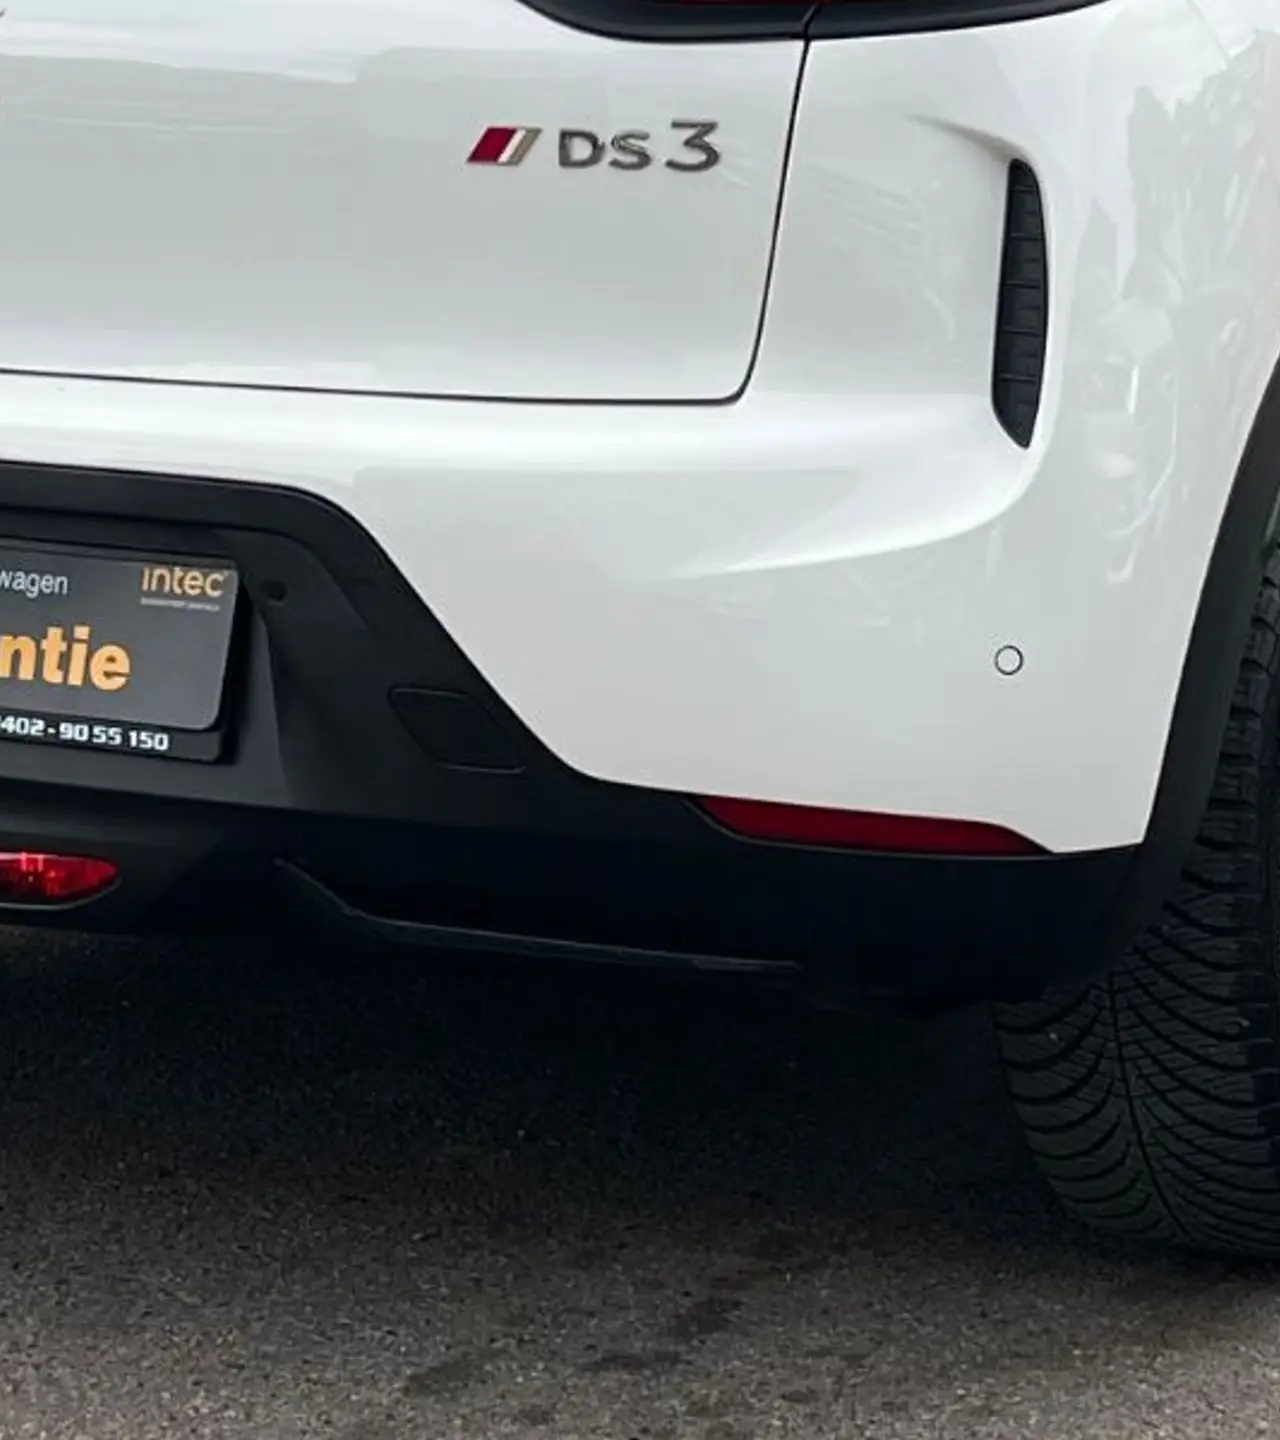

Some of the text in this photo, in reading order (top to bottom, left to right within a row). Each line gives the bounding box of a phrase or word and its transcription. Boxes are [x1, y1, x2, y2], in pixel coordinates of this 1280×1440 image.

[558, 120, 721, 172] DS 3
[128, 729, 170, 751] 150
